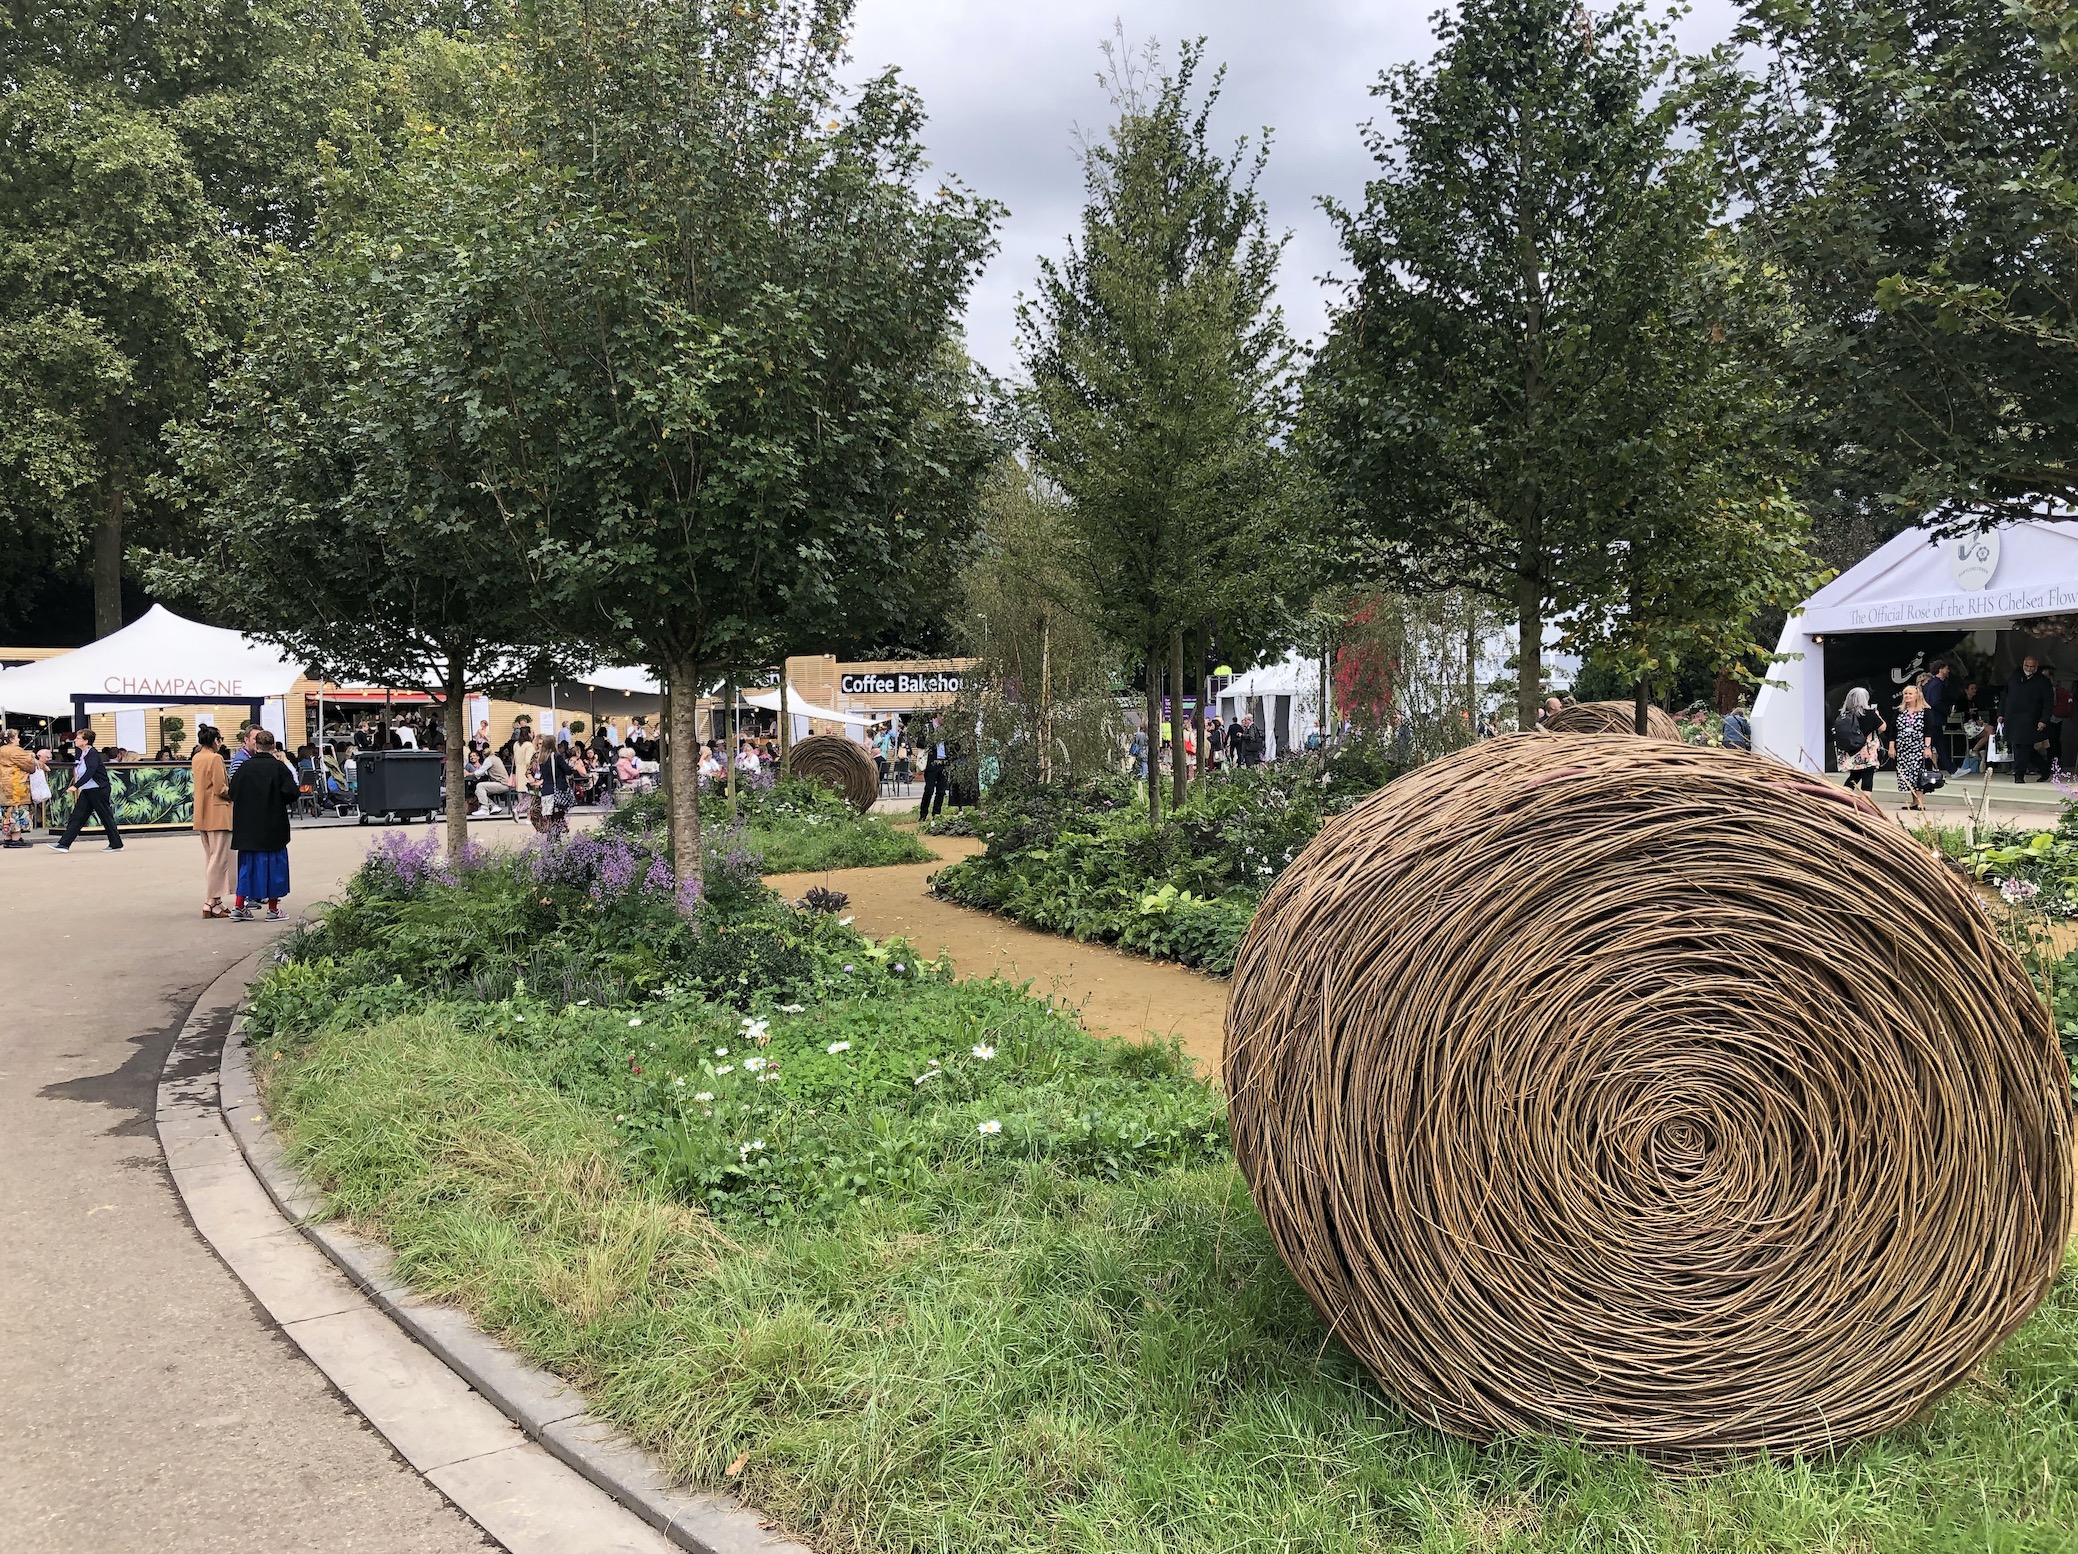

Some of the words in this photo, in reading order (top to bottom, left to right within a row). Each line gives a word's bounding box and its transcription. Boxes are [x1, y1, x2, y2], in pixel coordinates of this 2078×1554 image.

[1850, 611, 1866, 625] The
[1868, 604, 1904, 622] Official
[1907, 601, 1931, 619] Rosé
[1934, 599, 1947, 617] of
[1948, 599, 1964, 616] the
[1968, 596, 1994, 614] RHS
[1998, 591, 2044, 612] Chelsea
[104, 676, 242, 696] CHAMPAGNE
[842, 675, 894, 693] Coffee
